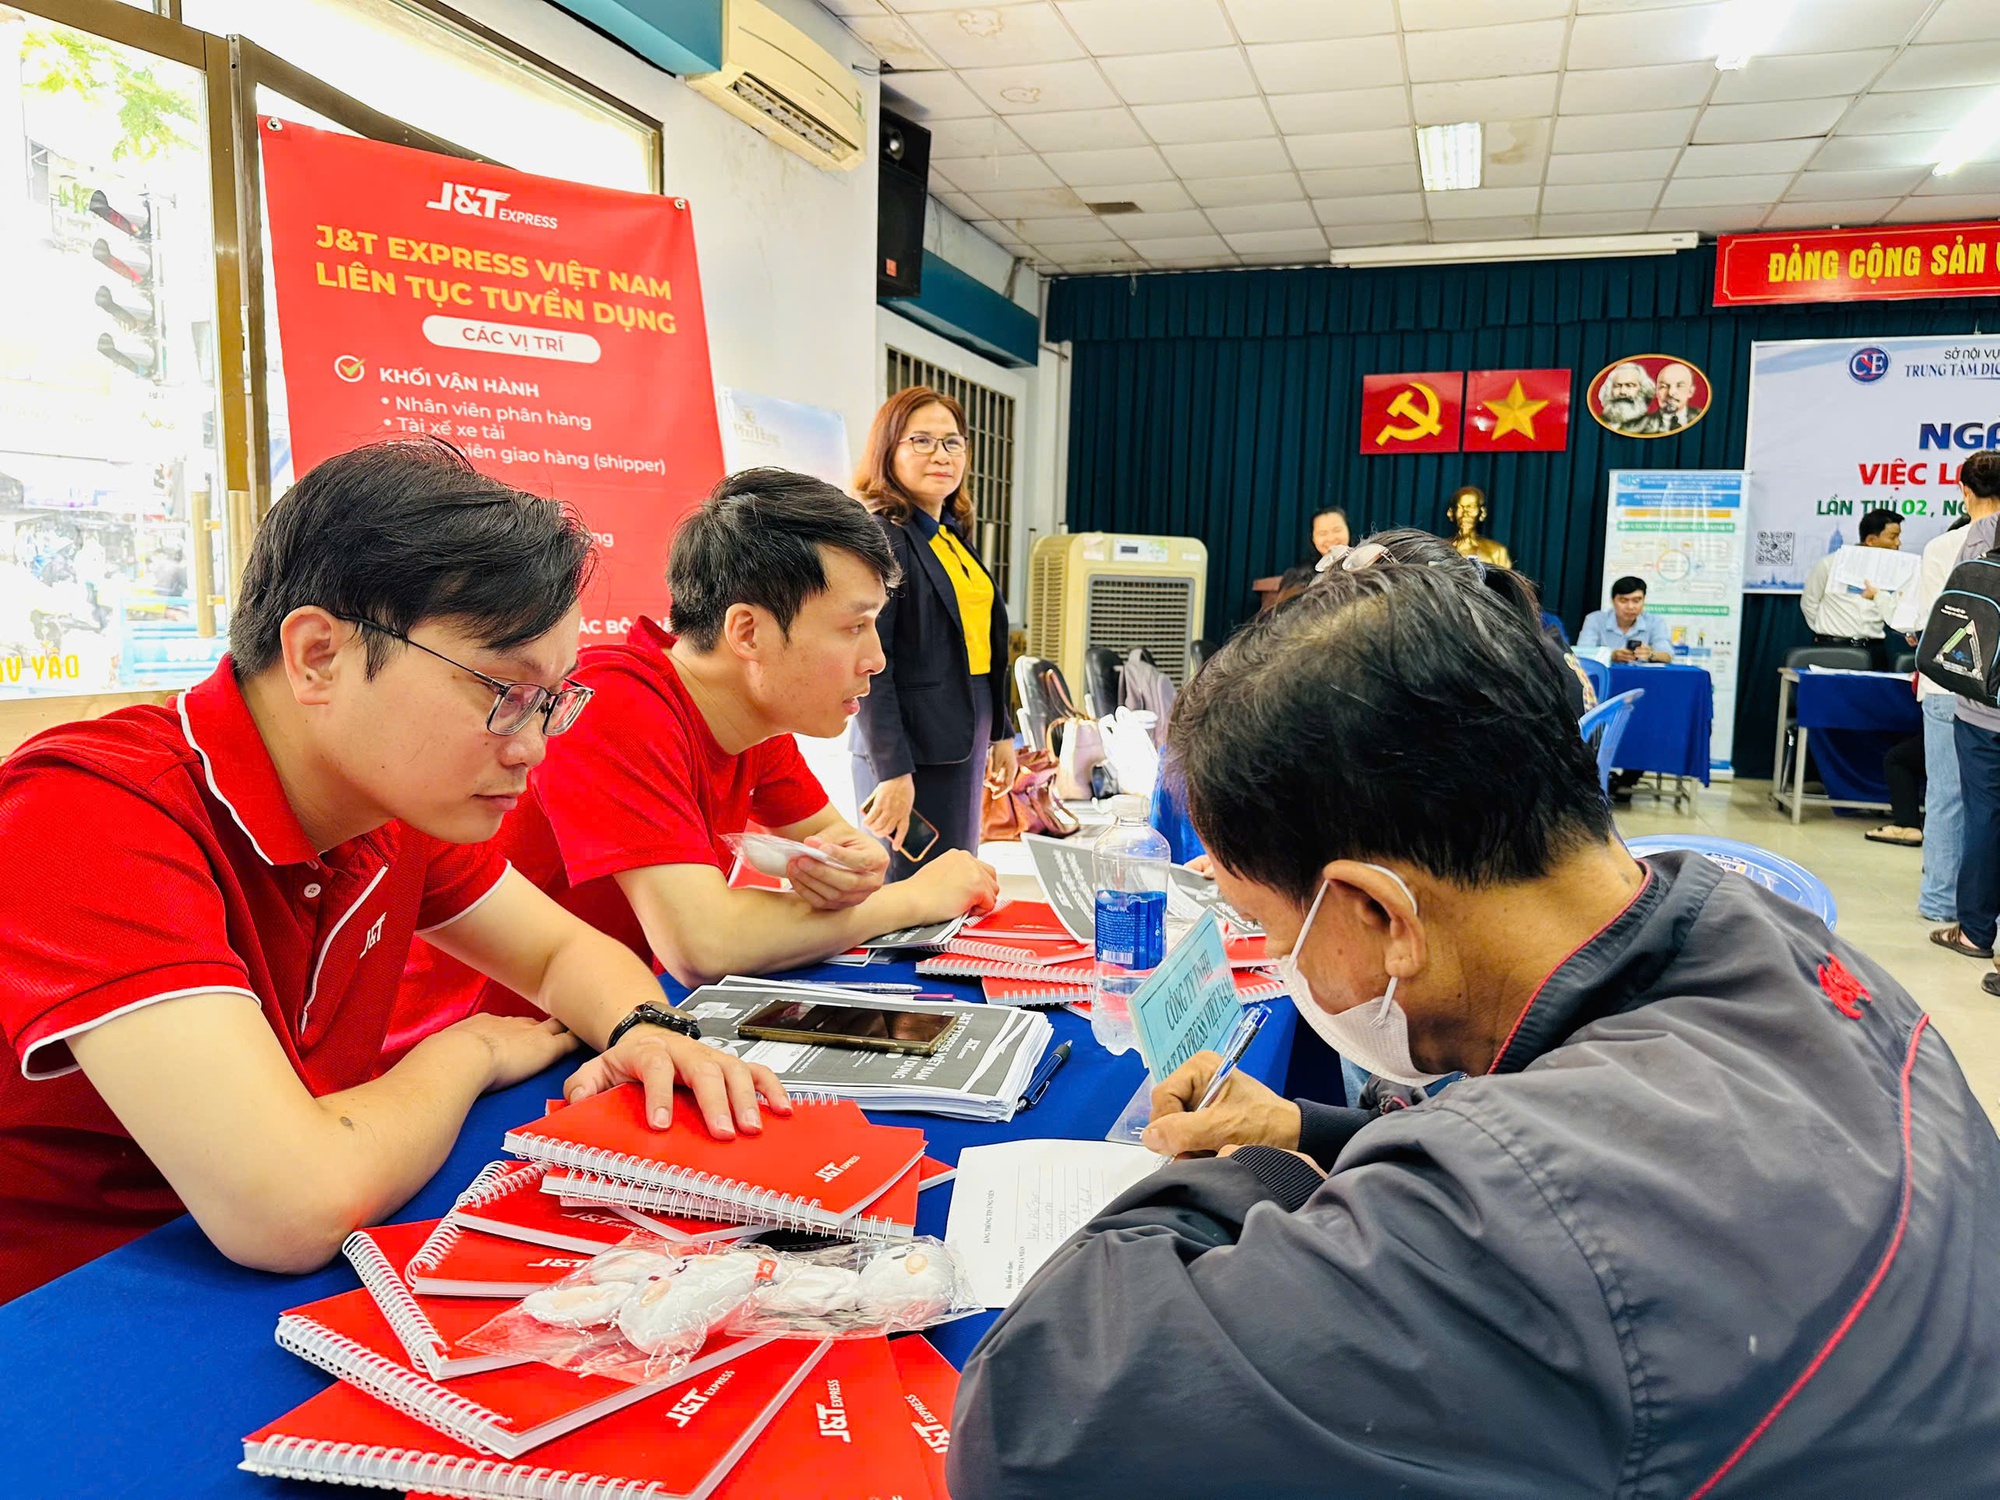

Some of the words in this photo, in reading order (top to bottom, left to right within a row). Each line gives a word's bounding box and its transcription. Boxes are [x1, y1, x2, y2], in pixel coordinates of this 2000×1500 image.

[426, 182, 511, 218] J&T
[499, 208, 558, 229] EXPRESS
[316, 224, 378, 255] J&T
[388, 237, 529, 278] EXPRESS
[535, 259, 600, 291] VIỆT
[609, 271, 671, 300] NAM
[1768, 243, 1839, 283] ĐẢNG
[1849, 242, 1921, 284] CỘNG
[1931, 235, 1986, 276] SẢN
[316, 261, 396, 295] LIÊN
[404, 275, 473, 308] TỤC
[480, 286, 585, 321] TUYỂN
[593, 302, 676, 334] DỤNG
[462, 326, 503, 344] CÁC
[509, 332, 528, 351] VỊ
[533, 335, 564, 352] TRÍ
[379, 367, 431, 387] KHỐI
[435, 372, 478, 393] VẬN
[484, 376, 540, 397] HÀNH
[1904, 364, 1946, 377] TRUNG
[1950, 360, 1977, 377] TÂM
[396, 396, 448, 414] Nhân
[452, 401, 491, 418] viên
[496, 407, 543, 424] phân
[547, 410, 592, 430] hàng
[396, 417, 425, 433] Tài
[430, 420, 452, 435] xế
[457, 426, 477, 437] xe
[482, 425, 505, 440] tải
[500, 449, 540, 464] giao
[544, 450, 590, 470] hàng
[594, 453, 666, 476] (shipper)
[1859, 458, 1927, 490] VIỆC
[1816, 495, 1852, 516] LẦN
[578, 617, 602, 634] ÁC
[359, 912, 387, 959] J&T
[1164, 987, 1188, 1031] CÔNG
[1184, 970, 1198, 1003] TY
[1203, 991, 1221, 1032] VIỆT
[1215, 974, 1235, 1016] NAM
[815, 1161, 846, 1183] J&T
[841, 1155, 861, 1172] EXPRESS
[561, 1211, 626, 1224] J&T
[527, 1257, 591, 1268] J&T
[666, 1387, 708, 1428] J&T
[707, 1369, 735, 1398] EXPRESS
[831, 1379, 839, 1412] EXPRESS
[904, 1394, 938, 1423] EXPRESS
[816, 1402, 851, 1443] J&T
